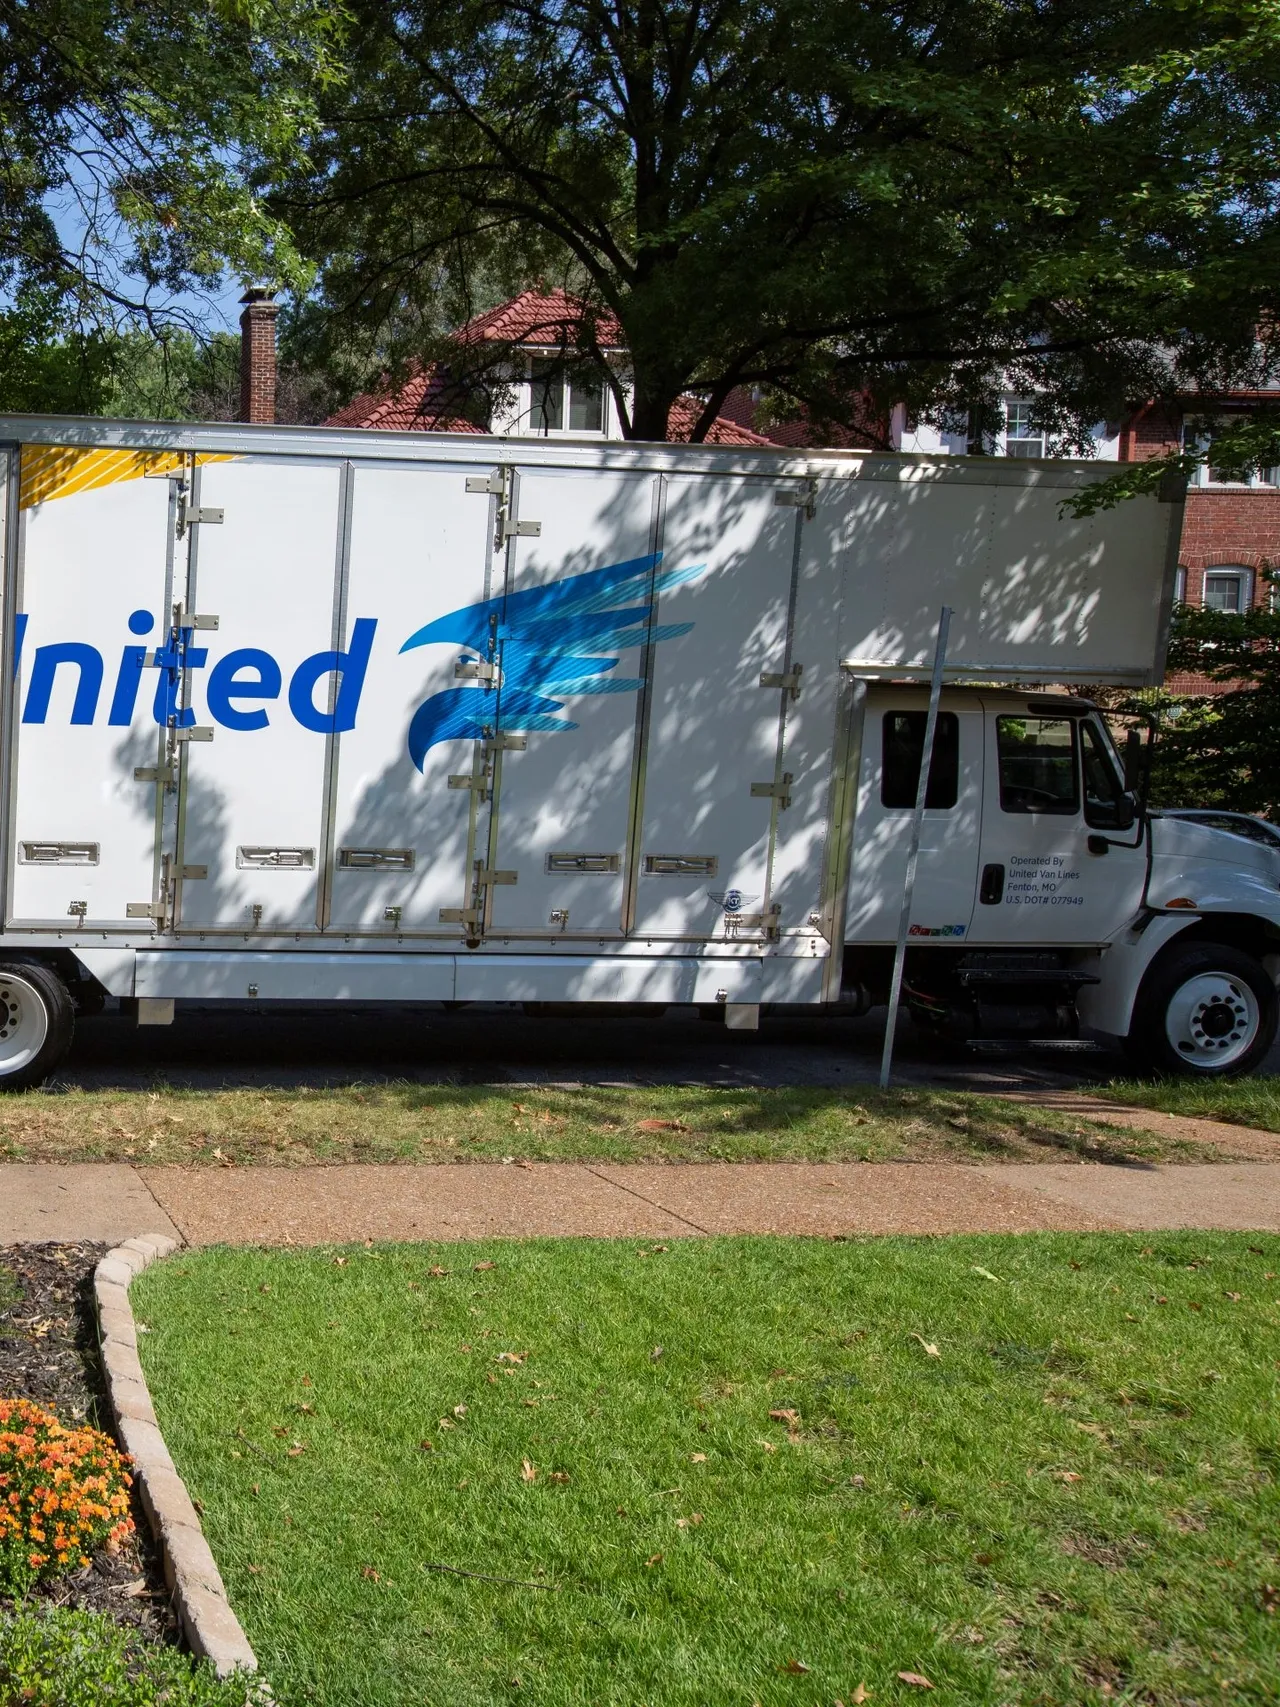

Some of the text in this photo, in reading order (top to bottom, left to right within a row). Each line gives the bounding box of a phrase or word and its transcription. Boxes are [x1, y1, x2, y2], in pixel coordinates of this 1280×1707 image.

[14, 609, 378, 734] nited
[1010, 856, 1064, 867] Operated By
[1009, 869, 1080, 879] United Van Lines
[1007, 883, 1056, 893] Fenton, MO
[1005, 896, 1084, 905] U.S. DOT# 077949
